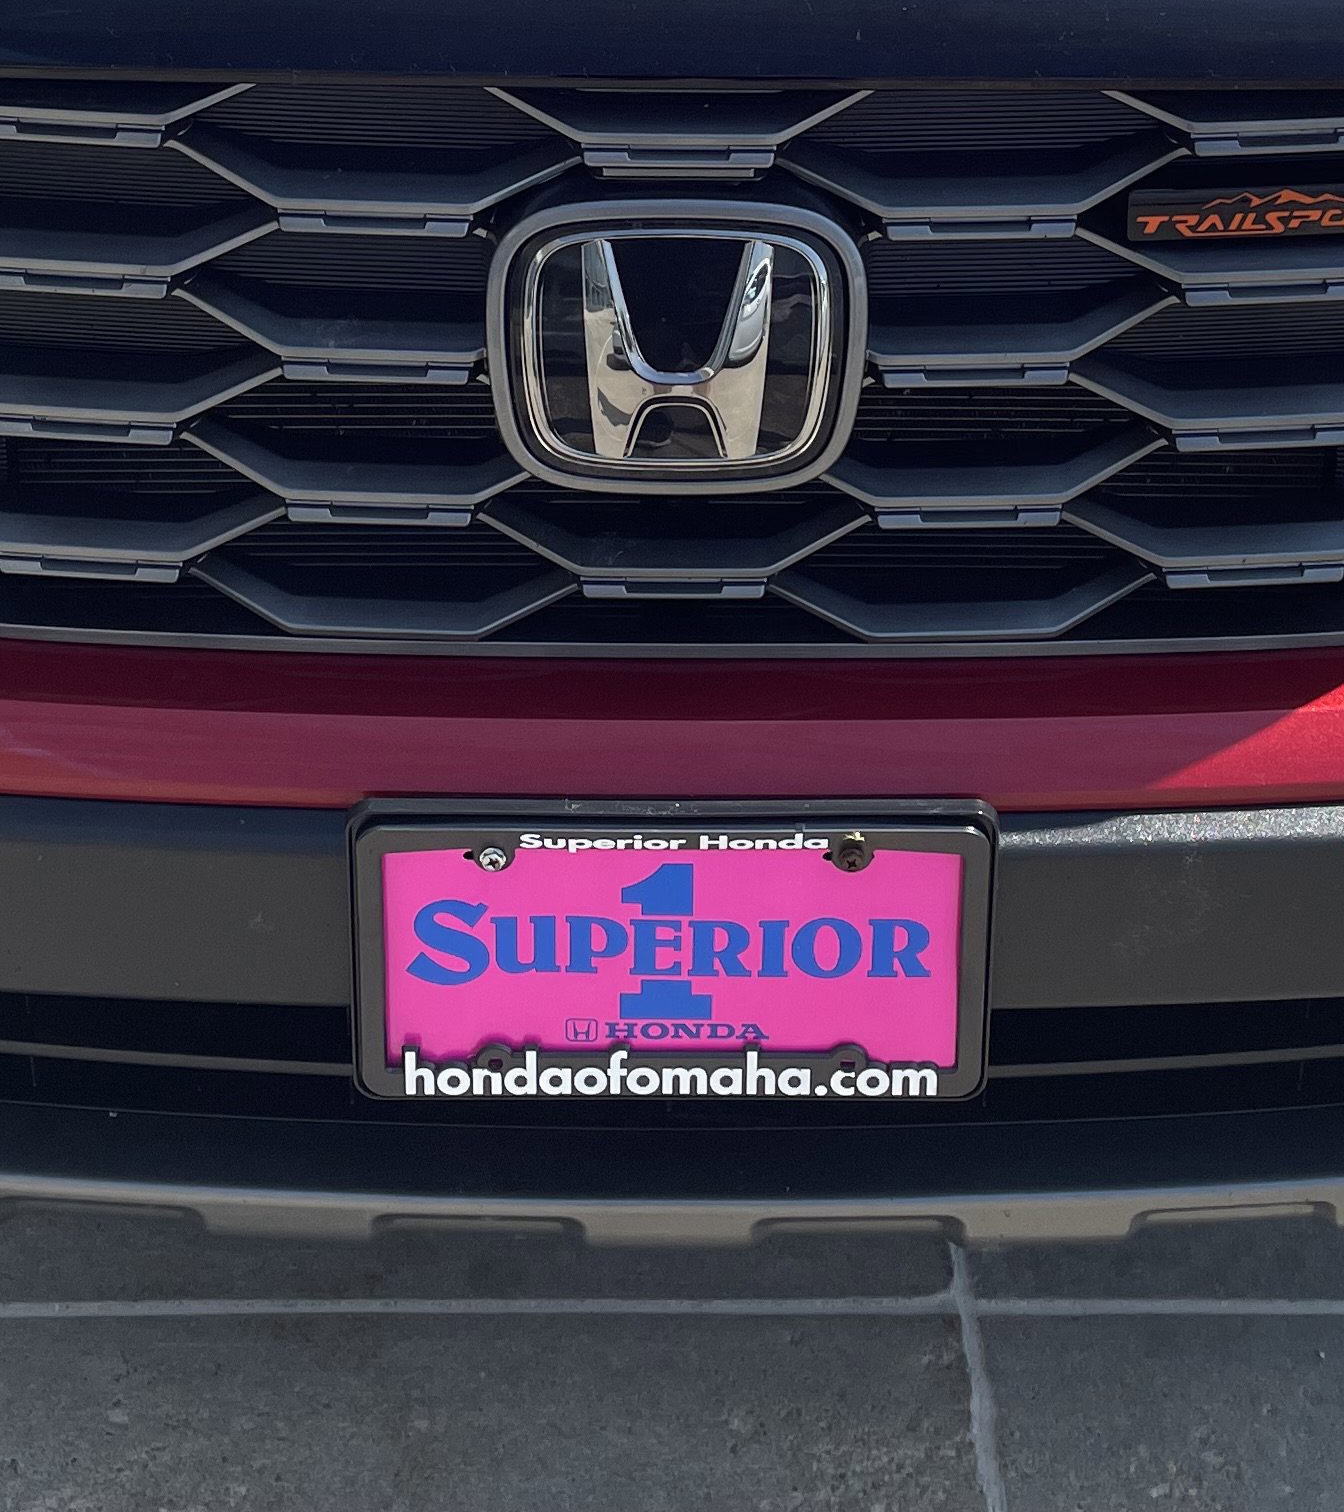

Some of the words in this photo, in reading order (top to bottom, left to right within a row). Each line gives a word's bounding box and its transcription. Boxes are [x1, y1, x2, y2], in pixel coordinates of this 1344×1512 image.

[519, 834, 687, 853] Superior
[700, 834, 829, 849] Honda
[406, 900, 931, 985] SUPERIOR
[605, 1022, 769, 1040] HONDA
[404, 1051, 939, 1097] hondaofomaha.com
